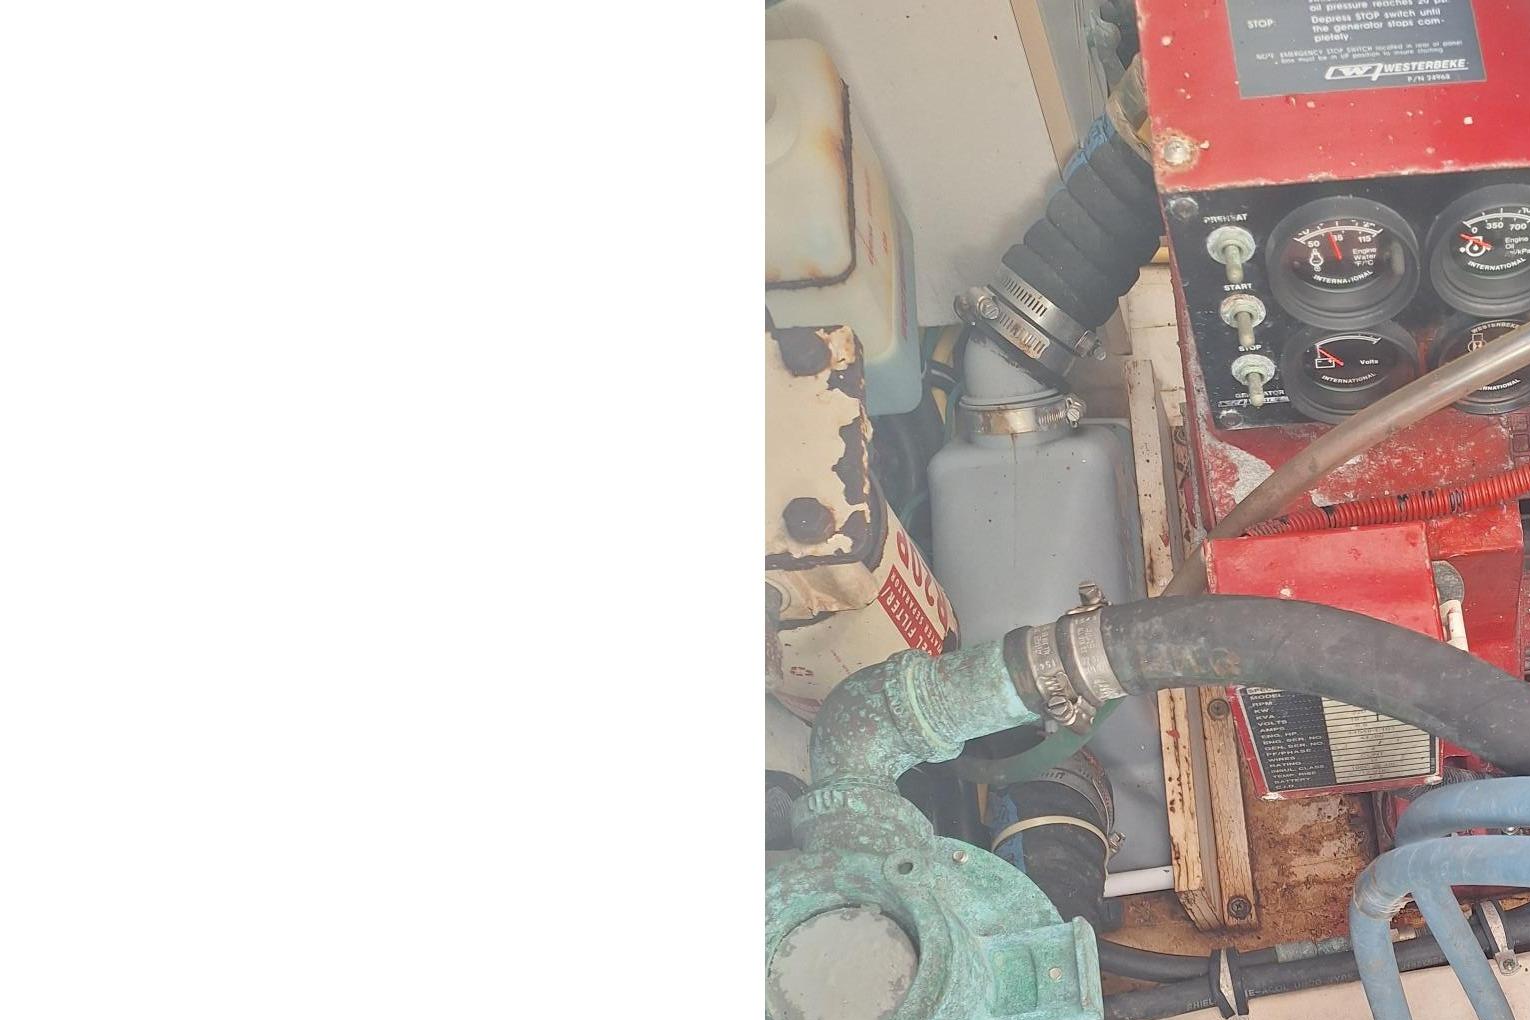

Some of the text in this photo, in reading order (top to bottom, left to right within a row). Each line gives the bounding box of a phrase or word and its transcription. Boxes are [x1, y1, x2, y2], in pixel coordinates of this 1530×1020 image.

[1326, 2, 1368, 12] pressure
[1311, 8, 1441, 24] Depress STOP switch until
[1312, 17, 1445, 33] the generator stops com-
[1383, 58, 1466, 73] WESTERBEKE
[1485, 221, 1504, 230] 350
[1509, 223, 1527, 231] 700
[1307, 240, 1320, 248] 50
[1358, 235, 1372, 243] 115
[1352, 247, 1377, 255] Engine
[1467, 257, 1527, 271] INTERNATIONAL
[1313, 270, 1374, 284] INTERNATIONAL
[1223, 283, 1253, 292] START
[1238, 344, 1262, 352] STOP
[1321, 372, 1376, 385] INTERNATIONAL
[889, 573, 924, 625] SEPARATOR
